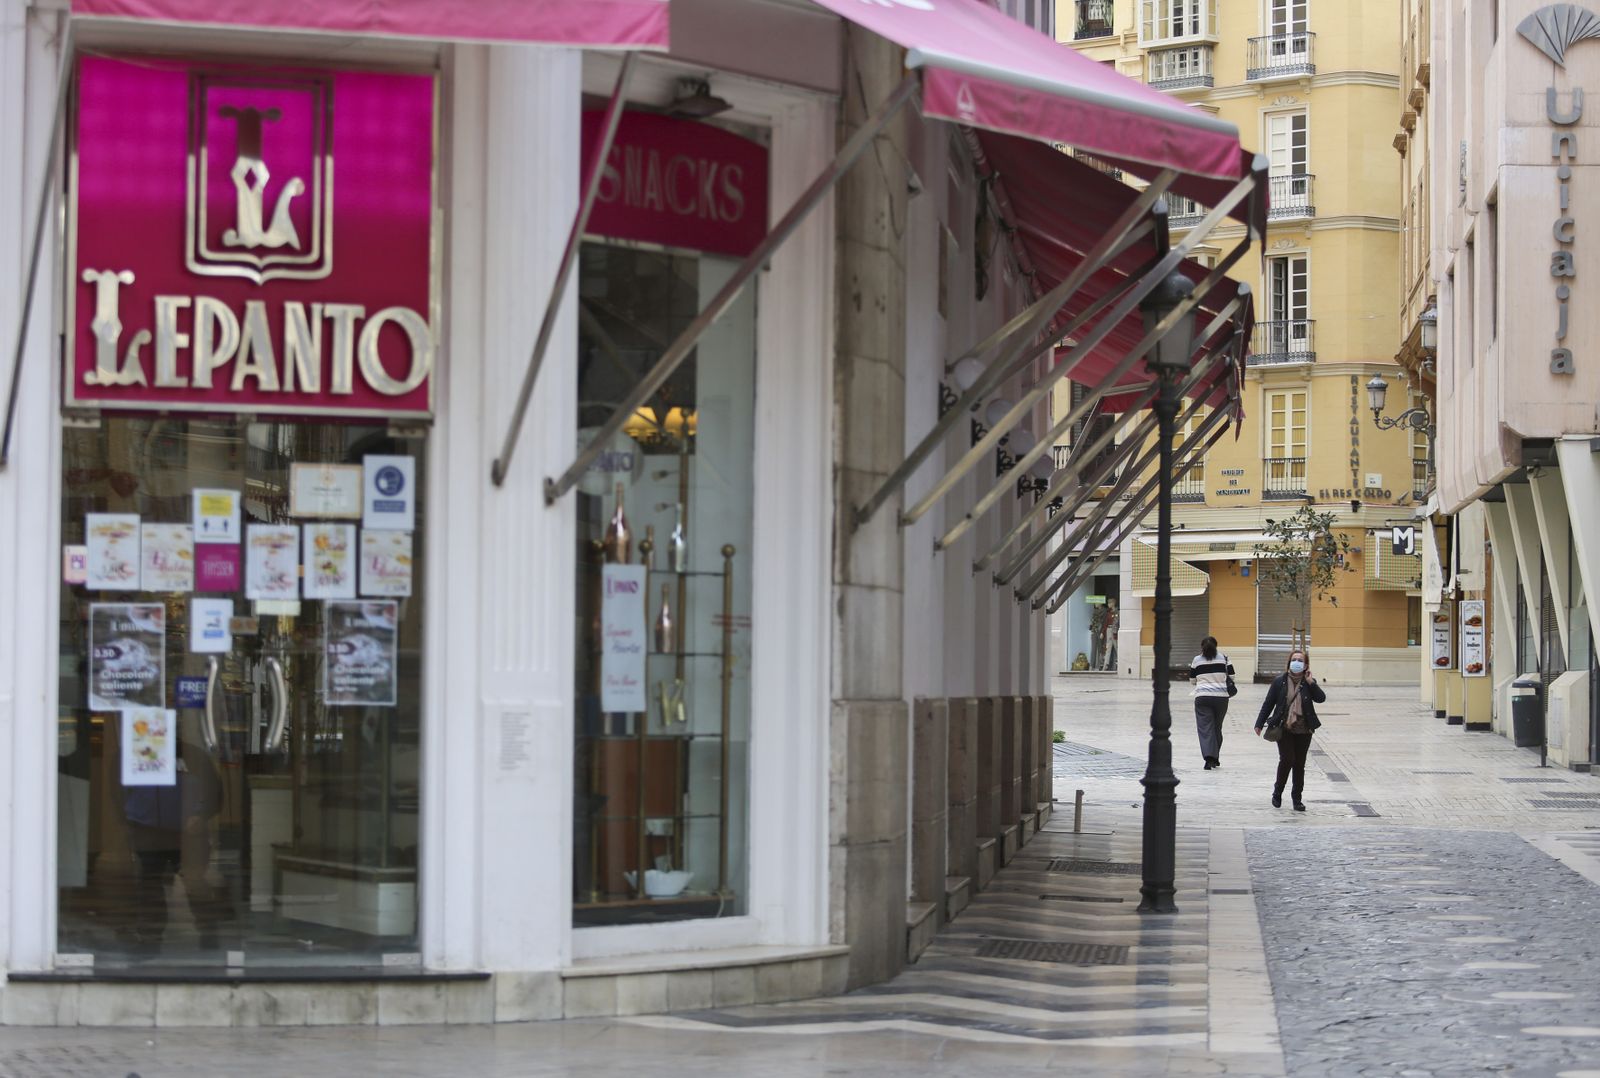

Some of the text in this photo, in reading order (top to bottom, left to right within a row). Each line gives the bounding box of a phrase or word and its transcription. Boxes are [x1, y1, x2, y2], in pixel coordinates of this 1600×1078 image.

[596, 144, 745, 222] SNACKS
[1546, 86, 1584, 375] Unicaja
[82, 268, 432, 395] LEPANTO
[1350, 374, 1361, 489] RESTAURANTE
